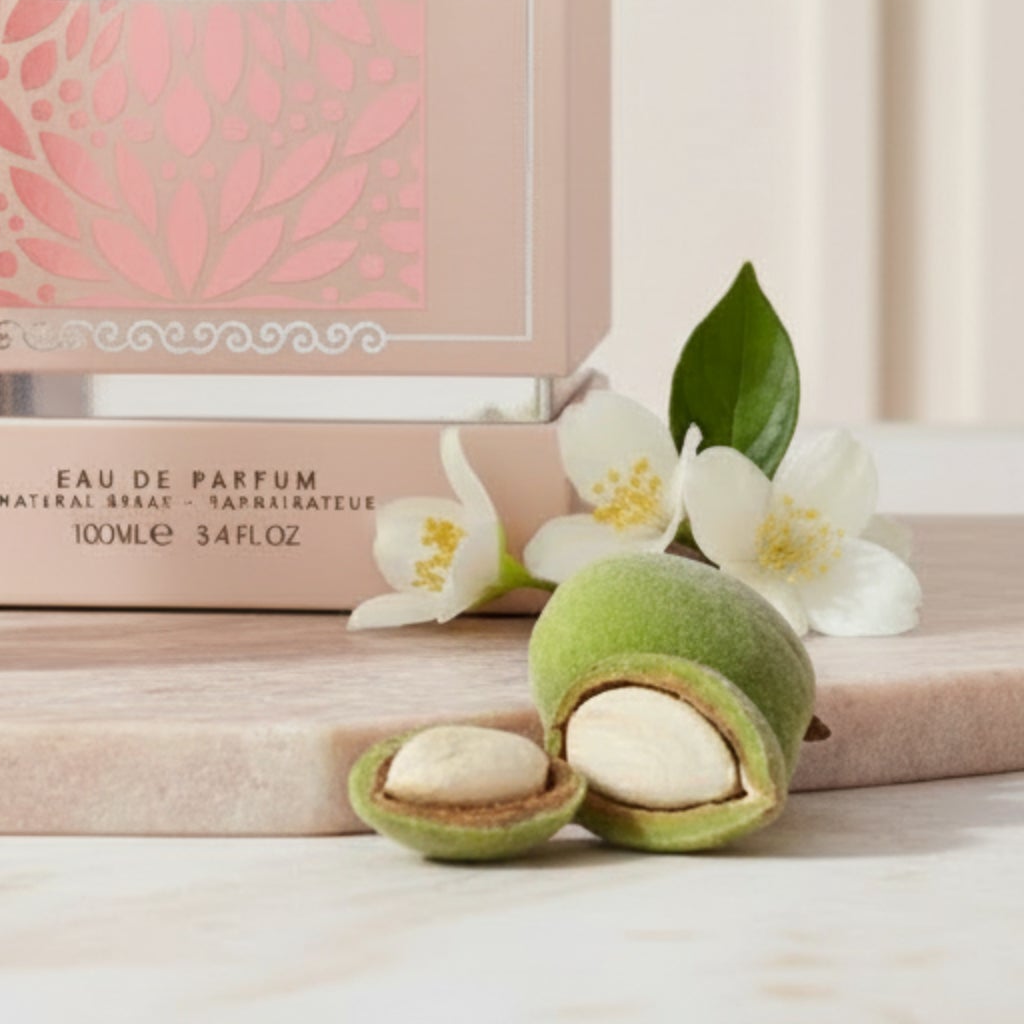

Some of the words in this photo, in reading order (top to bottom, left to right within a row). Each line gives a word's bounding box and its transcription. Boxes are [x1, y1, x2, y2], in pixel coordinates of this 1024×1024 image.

[57, 469, 114, 489] EAU
[133, 469, 170, 489] DE
[192, 470, 316, 490] PARFUM
